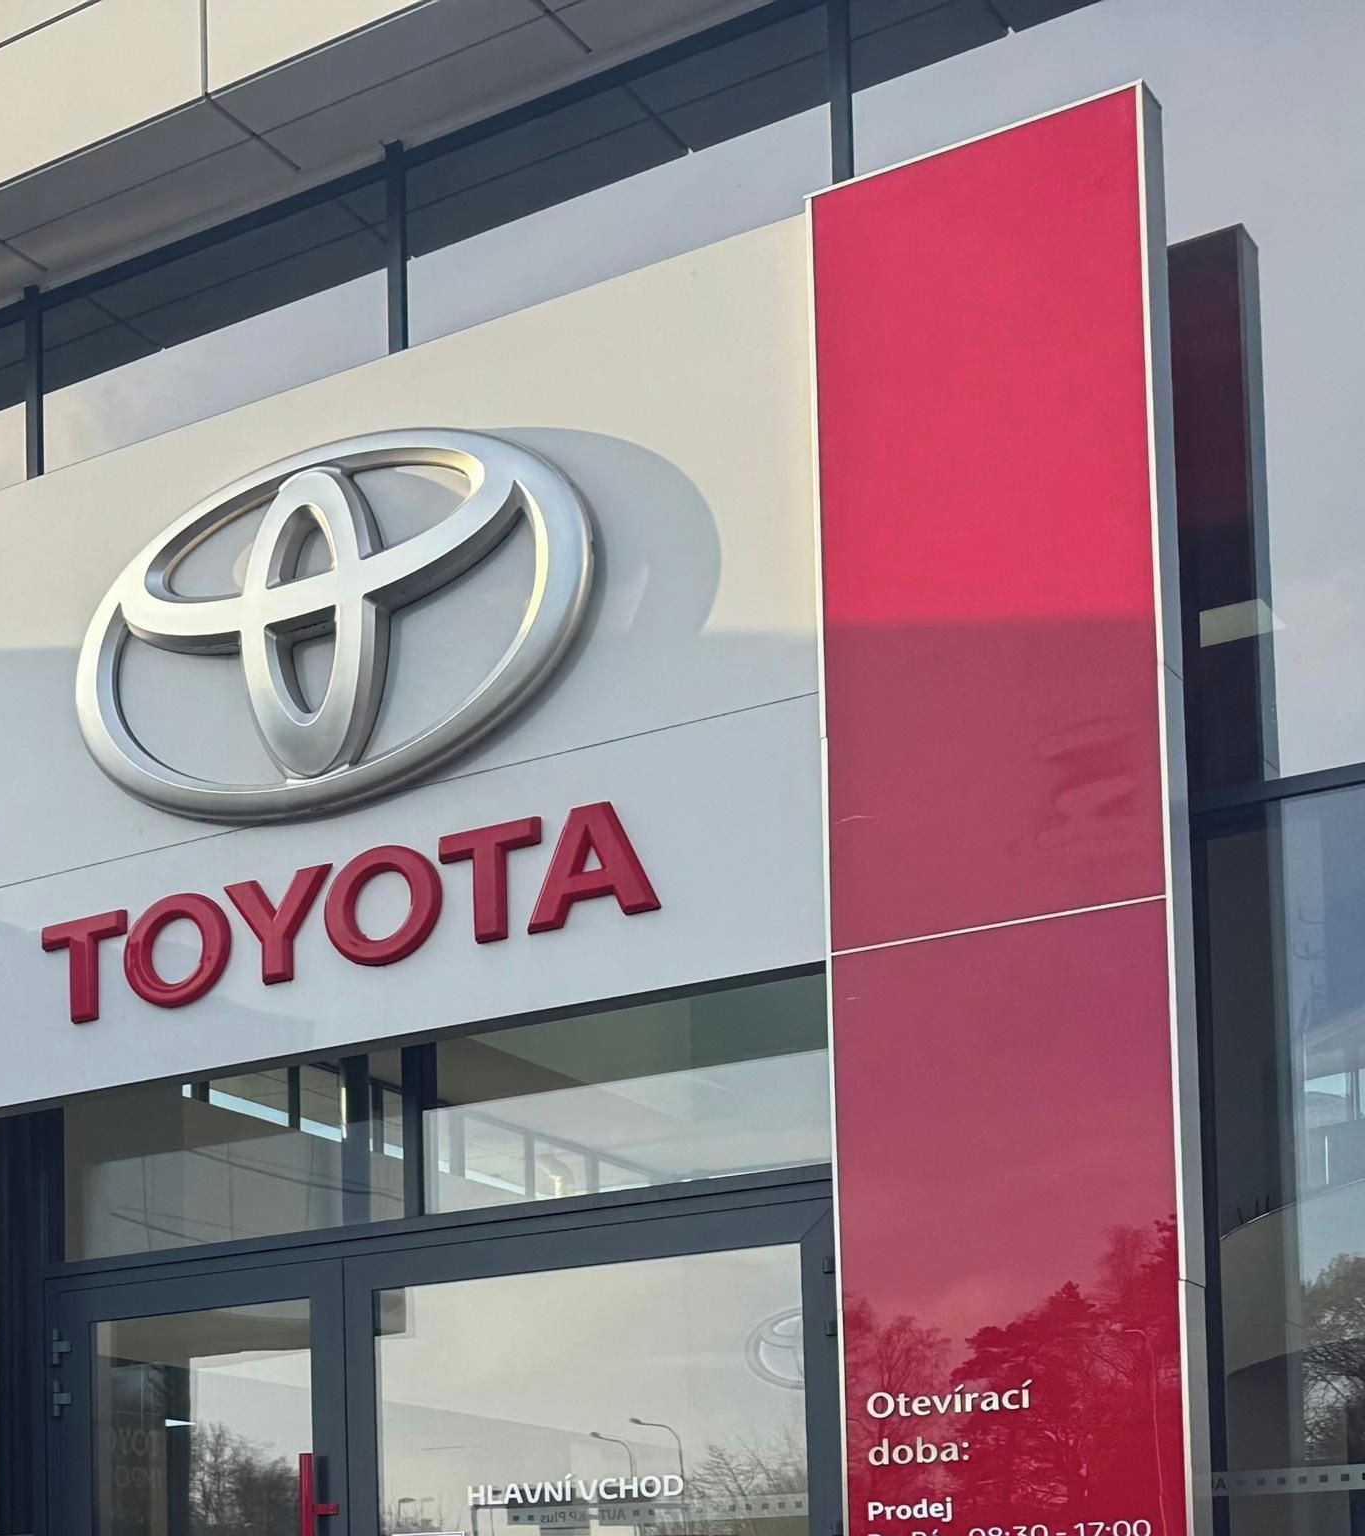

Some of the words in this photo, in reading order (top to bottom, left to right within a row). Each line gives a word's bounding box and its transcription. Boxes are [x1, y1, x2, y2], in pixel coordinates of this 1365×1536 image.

[42, 801, 661, 1024] TOYOTA
[867, 1379, 1034, 1419] Otevírací
[868, 1437, 971, 1467] doba:
[467, 1473, 571, 1506] HLAVNÍ
[577, 1474, 685, 1501] VCHOD
[867, 1497, 953, 1522] Prodej
